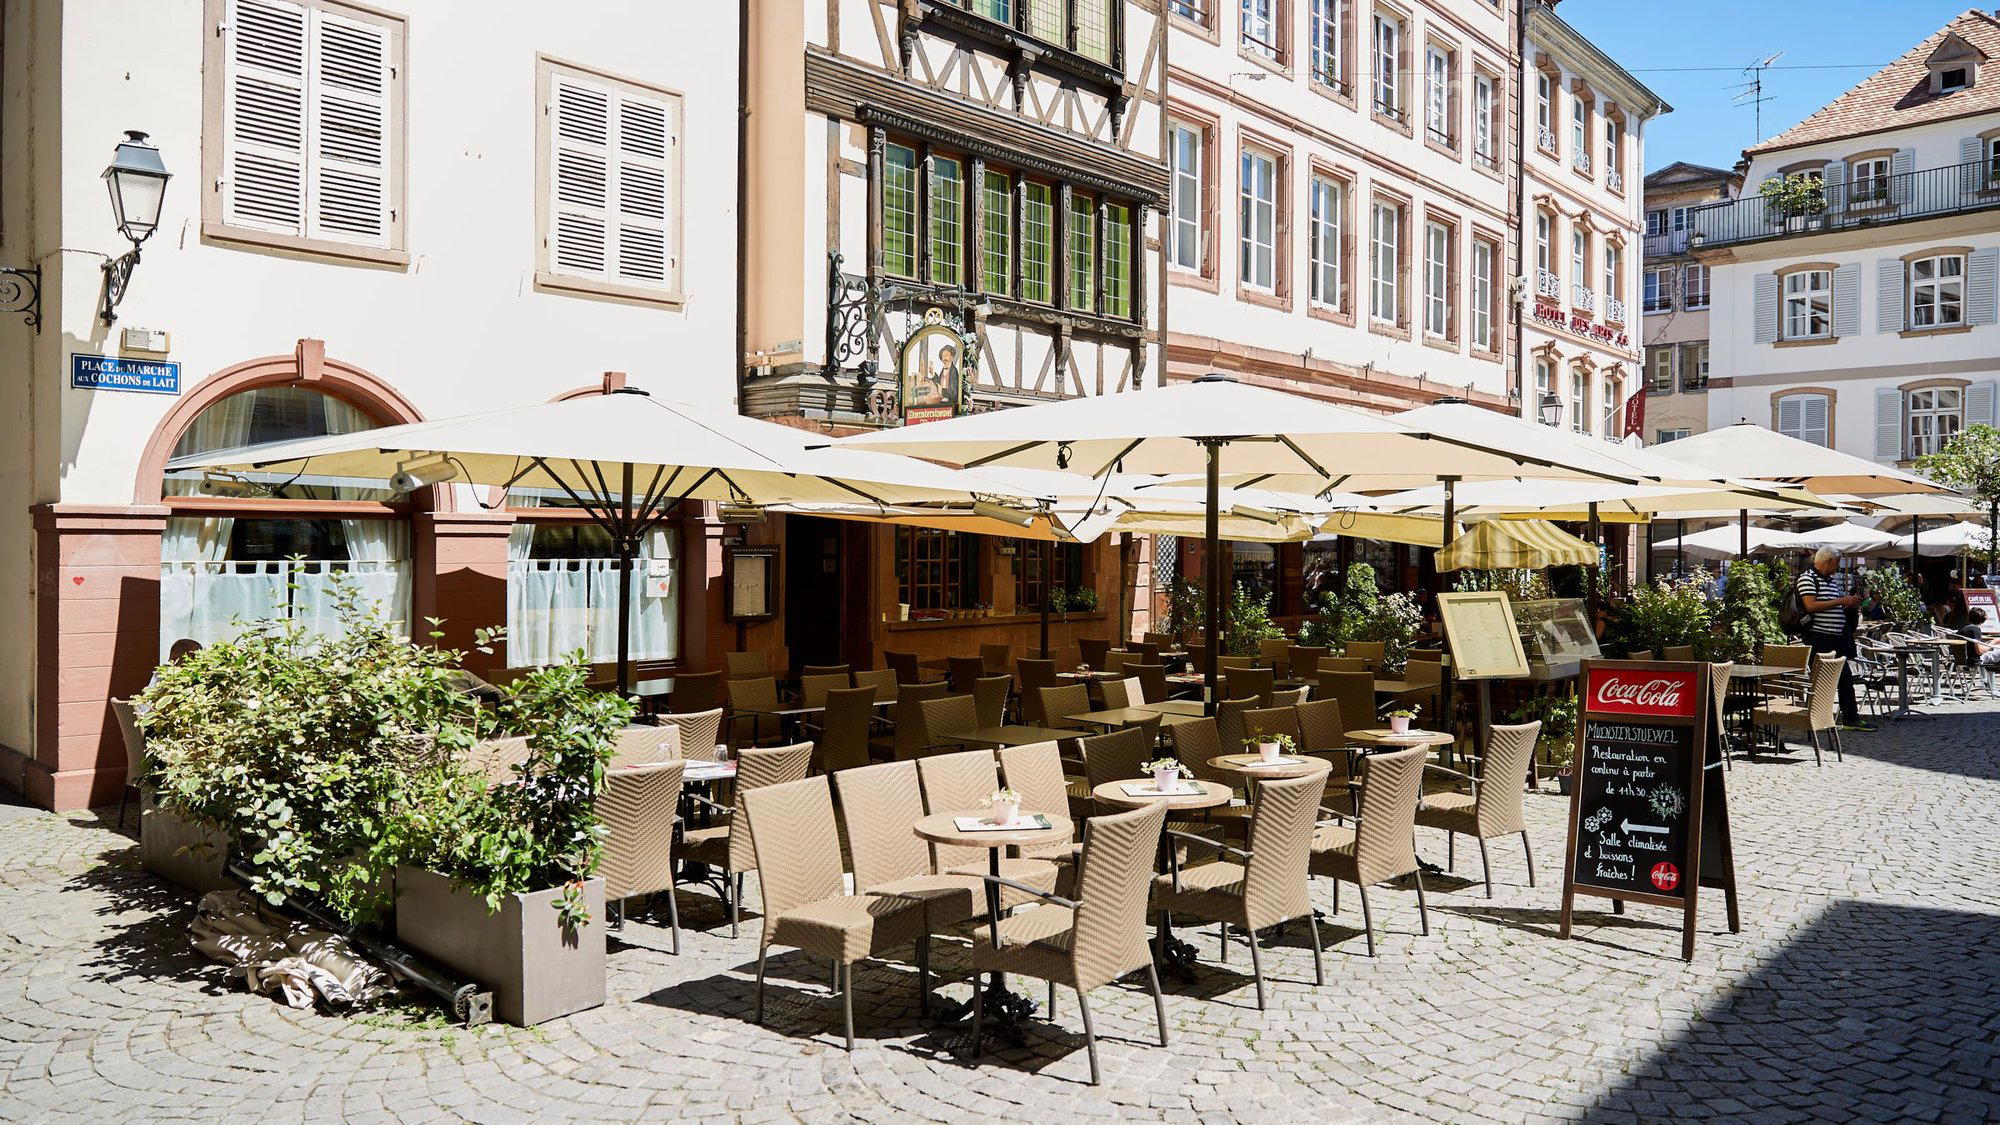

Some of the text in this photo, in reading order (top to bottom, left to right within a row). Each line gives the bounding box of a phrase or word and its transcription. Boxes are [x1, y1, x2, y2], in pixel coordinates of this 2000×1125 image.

[81, 360, 115, 372] PLACE
[116, 365, 126, 373] DU
[91, 373, 142, 386] COCHONS
[142, 379, 151, 387] DE
[152, 377, 176, 389] LAIT
[1592, 745, 1667, 764] Restauration en
[1591, 762, 1656, 782] continu à partir
[1605, 781, 1615, 795] de
[1599, 830, 1667, 852] Salle climatisée
[1584, 845, 1634, 863] et boissons
